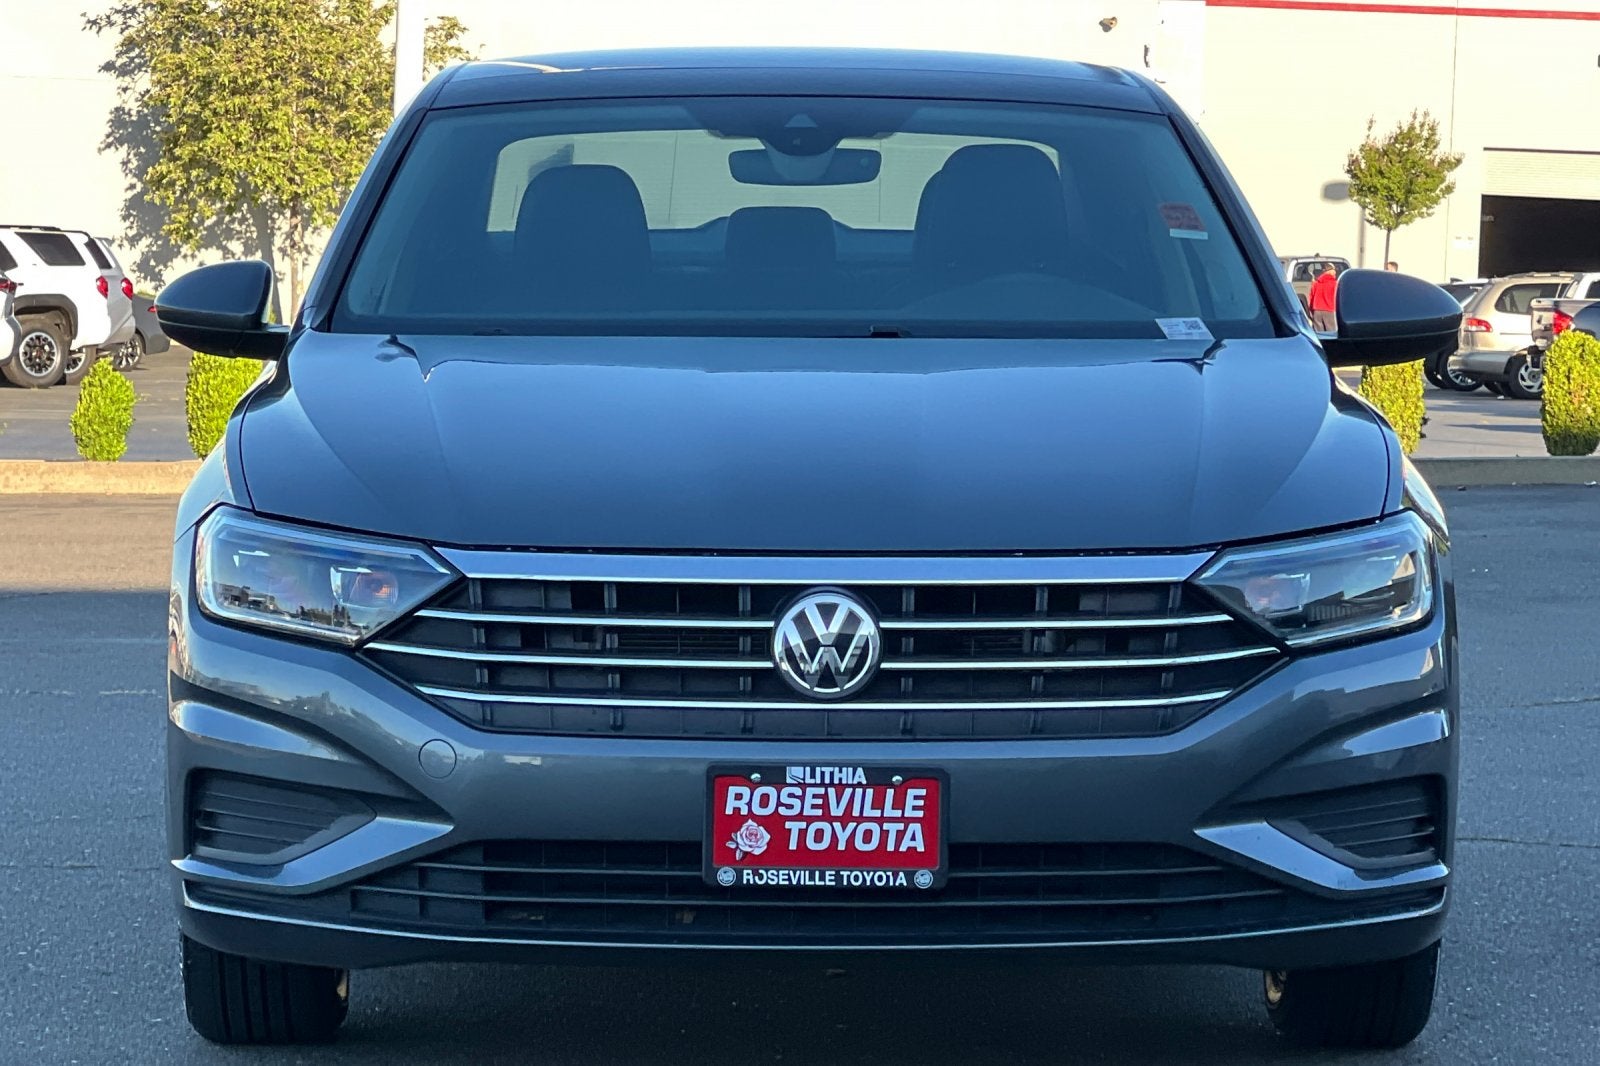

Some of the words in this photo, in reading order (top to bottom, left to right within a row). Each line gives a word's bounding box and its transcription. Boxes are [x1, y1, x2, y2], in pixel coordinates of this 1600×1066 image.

[773, 592, 880, 699] VW
[804, 767, 867, 785] LITHIA
[725, 785, 927, 818] ROSEVILLE
[784, 821, 926, 852] TOYOTA
[742, 869, 836, 887] ROSEVILLE
[841, 870, 908, 888] TOYOTA
